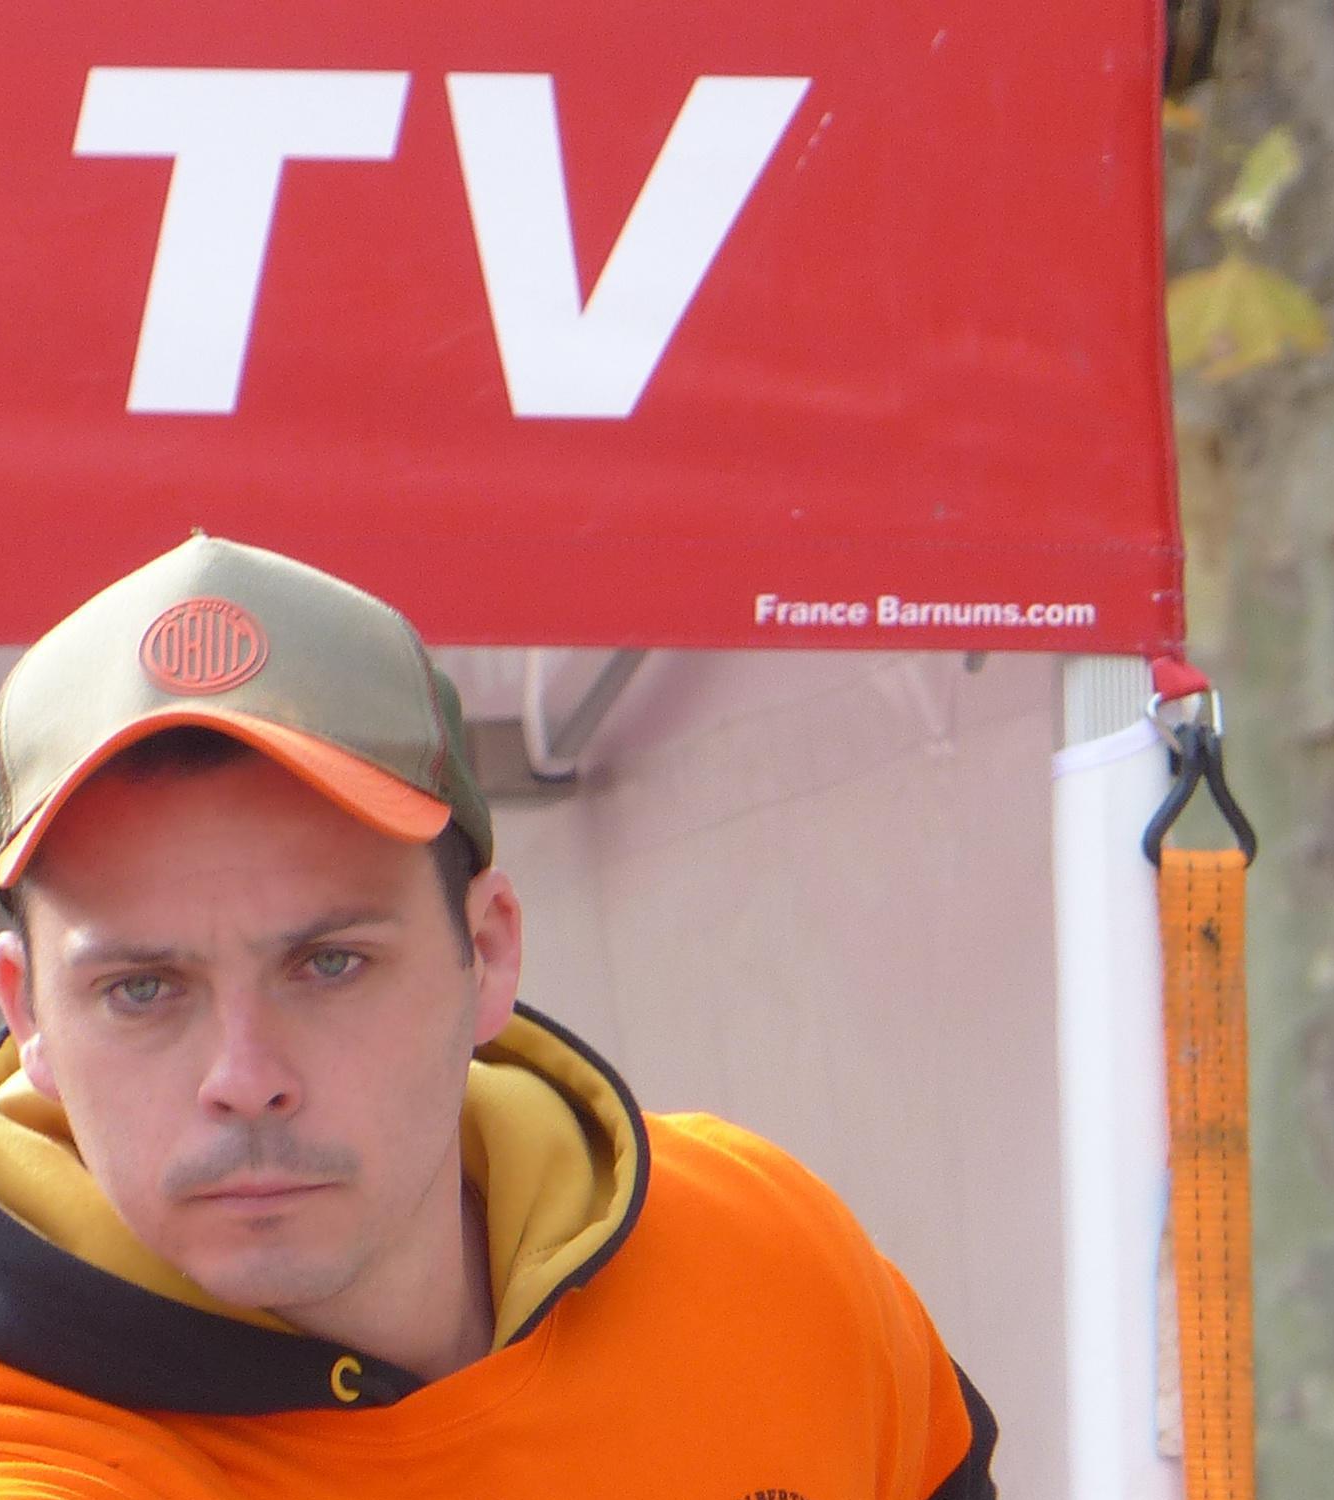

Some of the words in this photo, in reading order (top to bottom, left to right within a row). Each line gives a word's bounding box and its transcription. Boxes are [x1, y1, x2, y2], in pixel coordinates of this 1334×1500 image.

[73, 67, 812, 418] TV
[755, 594, 868, 626] France
[877, 595, 1096, 626] Barnums.com
